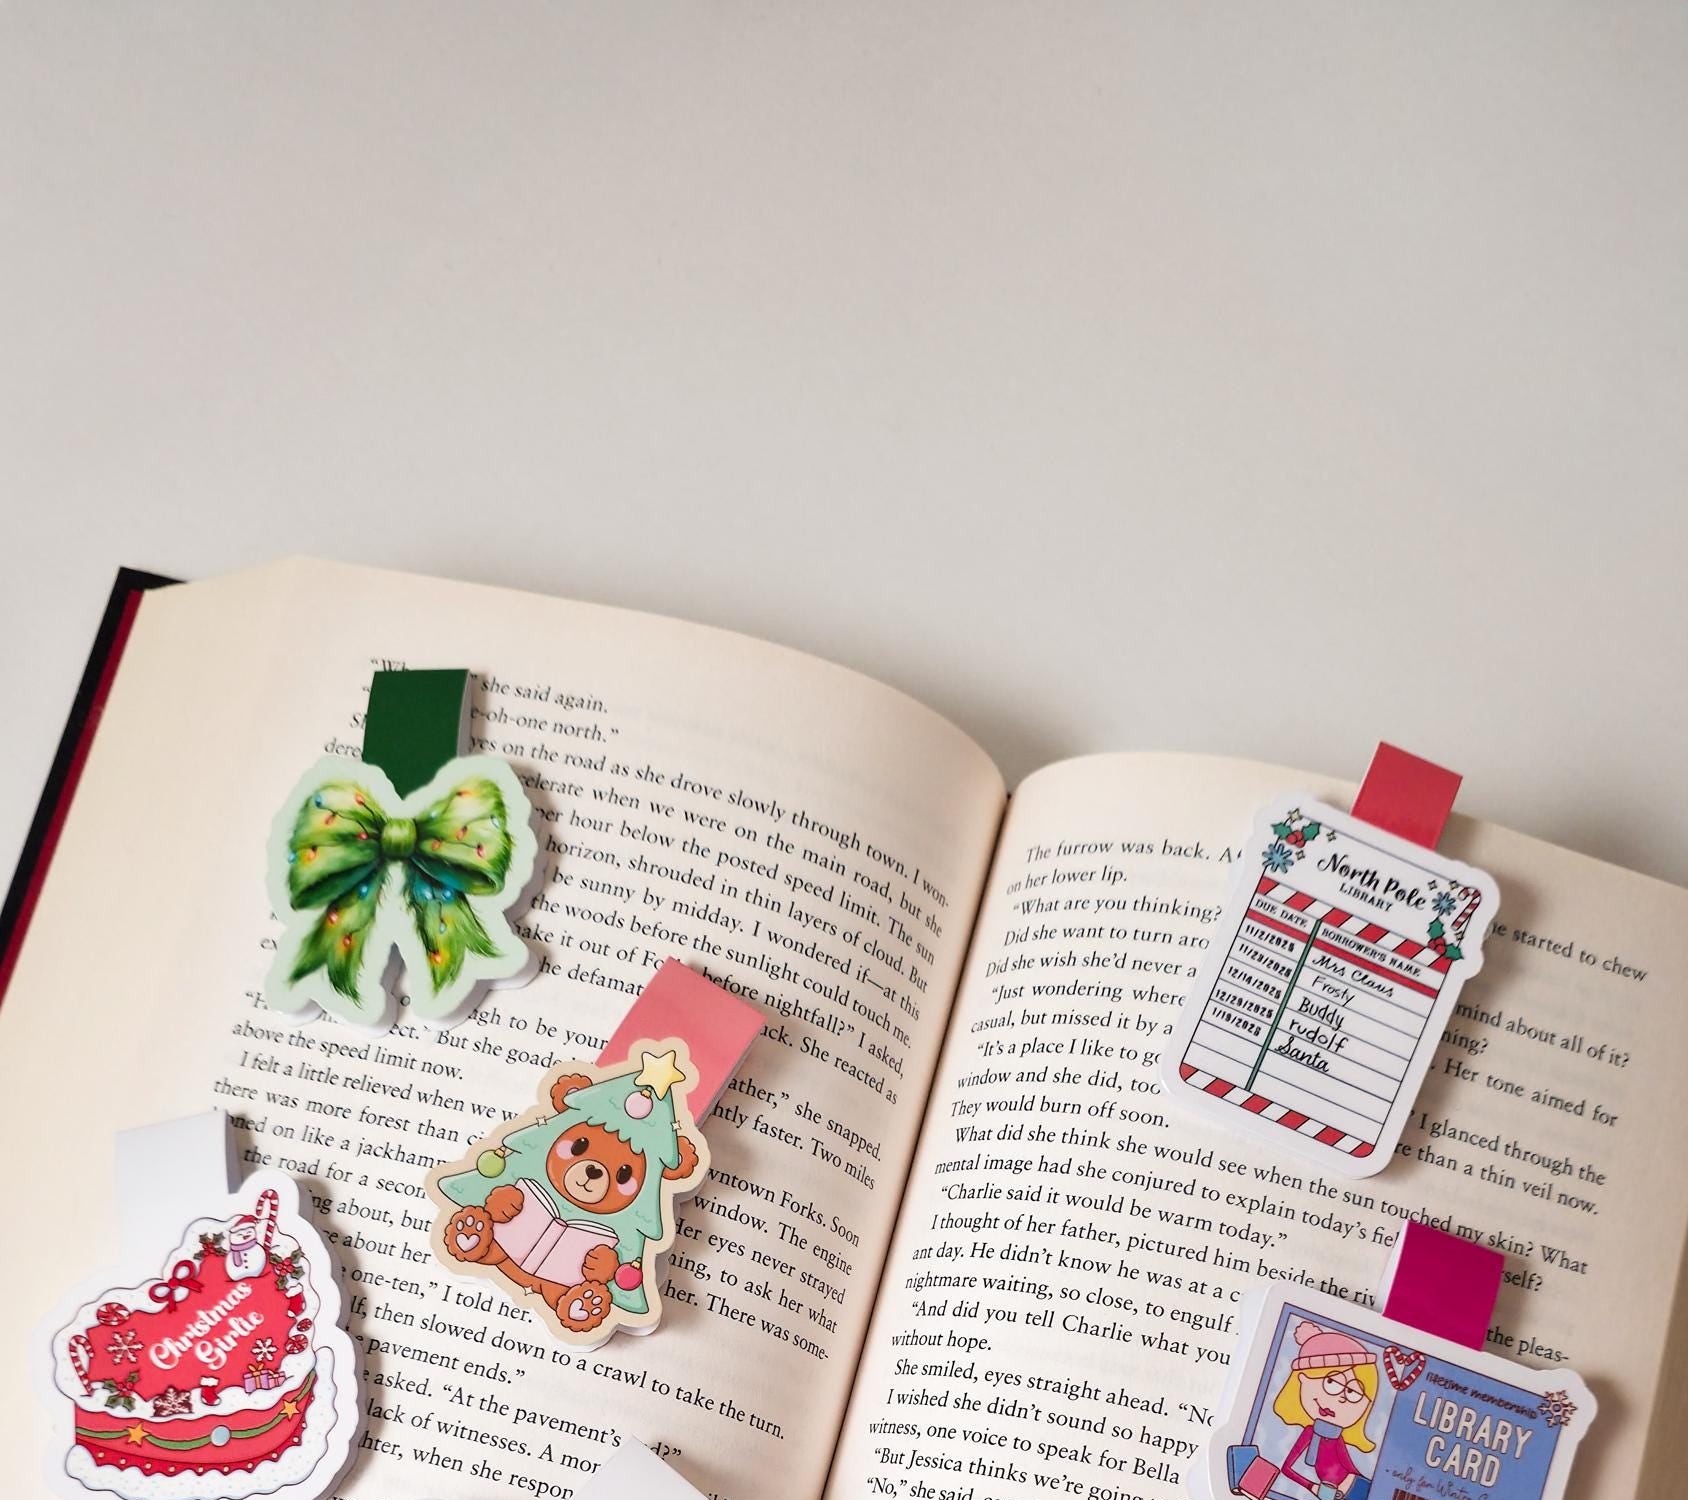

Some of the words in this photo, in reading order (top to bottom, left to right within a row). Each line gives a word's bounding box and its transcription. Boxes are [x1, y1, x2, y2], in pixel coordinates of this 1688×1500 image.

[502, 743, 525, 757] on
[530, 743, 559, 763] the
[564, 754, 607, 772] road
[610, 763, 630, 777] as
[634, 764, 666, 785] she
[670, 772, 723, 801] drove
[727, 789, 787, 824] slowly
[791, 810, 861, 852] through
[866, 844, 908, 879] town.
[912, 868, 920, 885] I
[922, 879, 949, 908] won-
[1027, 844, 1052, 864] The
[1056, 840, 1114, 857] furrow
[1121, 842, 1154, 855] was
[1161, 838, 1210, 861] back.
[1063, 898, 1091, 911] are
[1093, 898, 1127, 915] you
[1132, 895, 1223, 924] thinking?
[1317, 853, 1380, 897] North
[1383, 875, 1427, 911] Pole
[1339, 882, 1394, 913] LIBRARY
[1255, 898, 1278, 914] DUE
[1280, 909, 1308, 928] DATE
[1311, 975, 1355, 1007] Frosty
[1312, 955, 1345, 977] Mrs
[1351, 969, 1394, 998] Claus
[1388, 953, 1422, 978] NAME
[1298, 996, 1345, 1032] Buddy
[1455, 1003, 1503, 1028] mind
[1505, 1016, 1557, 1046] about
[1559, 1034, 1584, 1054] all
[1586, 1044, 1608, 1061] of
[1608, 1052, 1630, 1068] it?
[231, 1019, 285, 1044] above
[287, 1030, 316, 1050] the
[319, 1040, 372, 1061] speed
[373, 1045, 418, 1071] limit
[420, 1061, 463, 1081] now.
[1274, 1036, 1330, 1073] Santa
[239, 1050, 249, 1067] I
[250, 1055, 281, 1074] felt
[282, 1064, 294, 1077] a
[297, 1061, 340, 1086] little
[341, 1073, 414, 1101] relieved
[416, 1088, 465, 1113] when
[470, 1102, 497, 1119] we
[951, 1099, 983, 1118] They
[985, 1093, 1037, 1113] would
[1039, 1094, 1082, 1115] burn
[1087, 1100, 1118, 1119] off
[1118, 1109, 1169, 1129] soon.
[934, 1152, 982, 1175] mental
[983, 1153, 1034, 1176] image
[1036, 1154, 1073, 1175] had
[1075, 1159, 1108, 1180] she
[1111, 1170, 1197, 1197] conjured
[1201, 1185, 1221, 1202] to
[1225, 1193, 1296, 1221] explain
[1417, 1145, 1458, 1172] than
[1463, 1163, 1474, 1177] a
[1479, 1164, 1516, 1190] thin
[1522, 1181, 1554, 1201] veil
[1556, 1192, 1599, 1216] now.
[1005, 1184, 1043, 1203] said
[1045, 1186, 1061, 1205] it
[1064, 1194, 1125, 1214] would
[1129, 1198, 1152, 1219] be
[1157, 1209, 1213, 1233] warm
[149, 1282, 252, 1370] Christmas
[194, 1311, 265, 1371] Girlie
[706, 1292, 756, 1327] There
[760, 1319, 790, 1342] was
[792, 1334, 829, 1360] some-
[373, 1302, 415, 1327] then
[419, 1313, 488, 1344] slowed
[490, 1330, 546, 1361] down
[551, 1349, 572, 1367] to
[575, 1358, 587, 1372] a
[592, 1363, 648, 1389] crawl
[651, 1378, 671, 1396] to
[675, 1386, 715, 1411] take
[718, 1399, 746, 1423] the
[749, 1413, 784, 1440] turn.
[1412, 1391, 1533, 1460] LIBRARY
[1425, 1435, 1500, 1488] CARD
